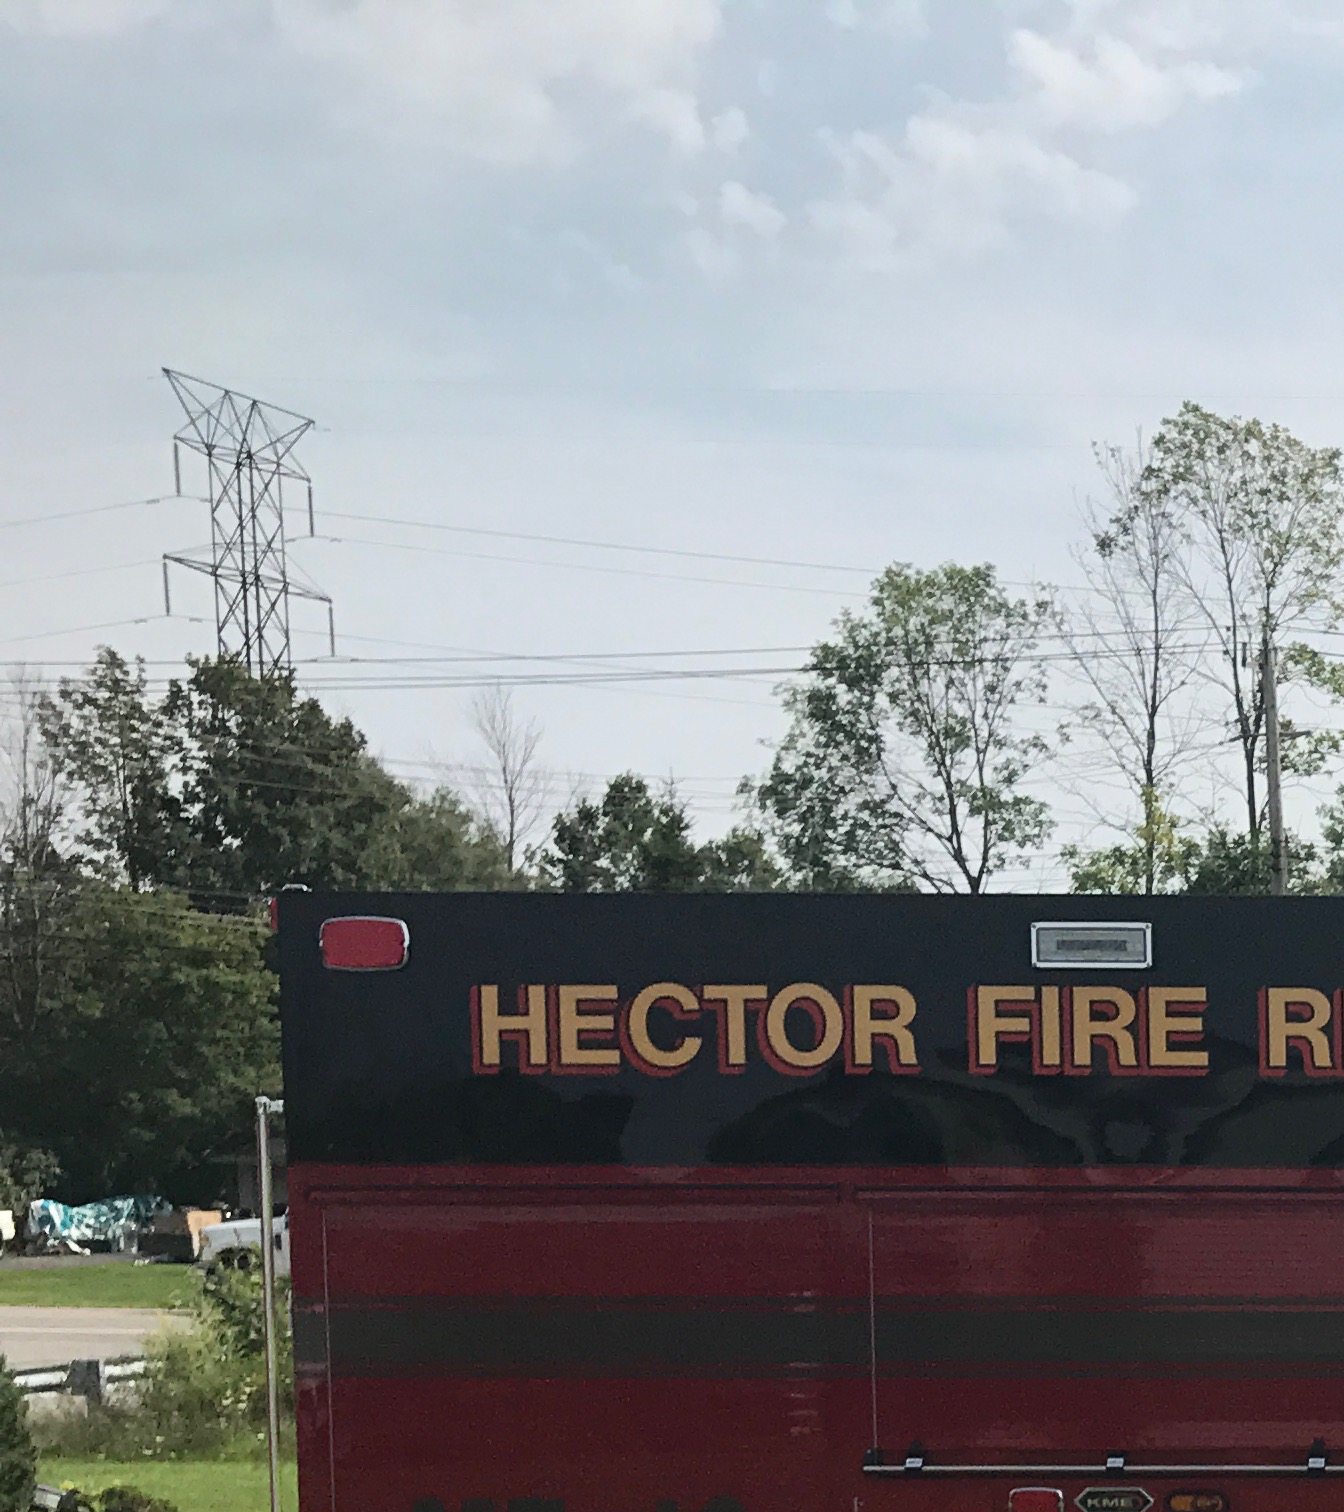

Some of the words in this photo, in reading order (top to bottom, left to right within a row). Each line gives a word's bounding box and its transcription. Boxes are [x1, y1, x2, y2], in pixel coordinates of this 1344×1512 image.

[470, 983, 920, 1076] HECTOR
[968, 985, 1209, 1077] FIRE
[1086, 1498, 1133, 1508] KME
